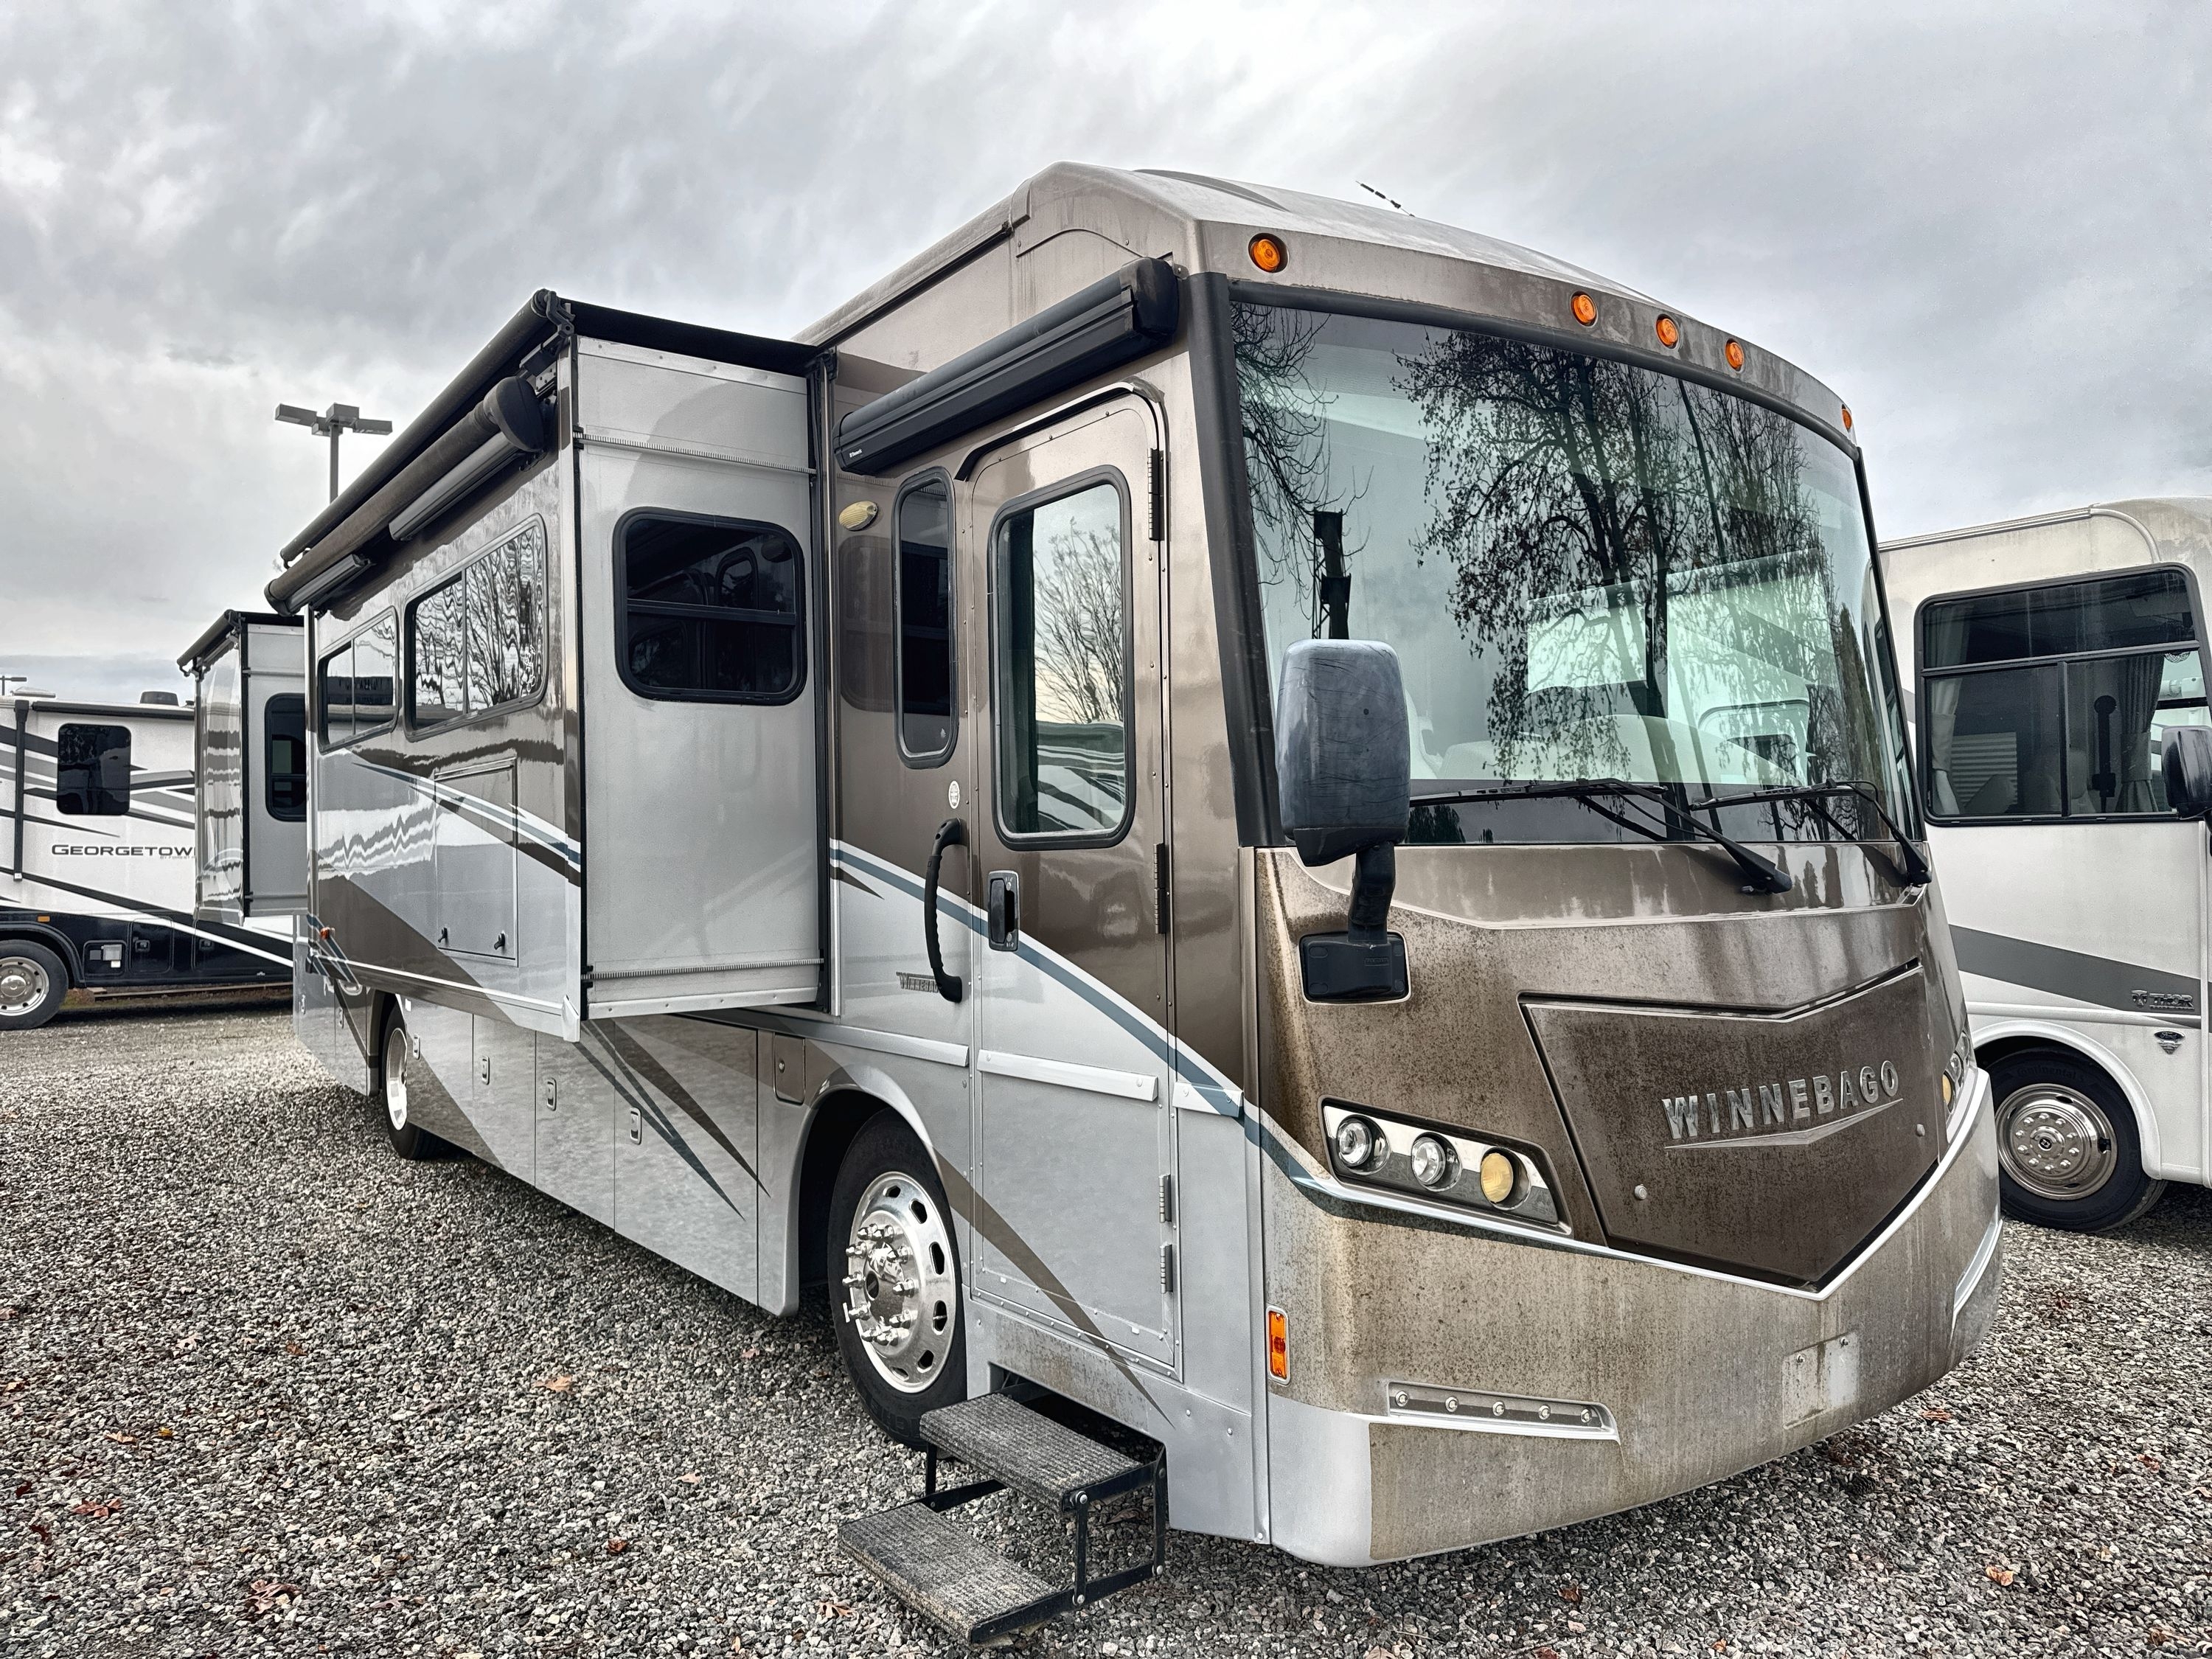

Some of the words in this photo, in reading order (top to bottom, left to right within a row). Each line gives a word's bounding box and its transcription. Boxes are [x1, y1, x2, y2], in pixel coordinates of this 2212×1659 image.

[52, 844, 196, 856] GEORGETOW
[2149, 993, 2194, 1007] THOR
[1661, 1060, 1899, 1139] WINNEBAGO
